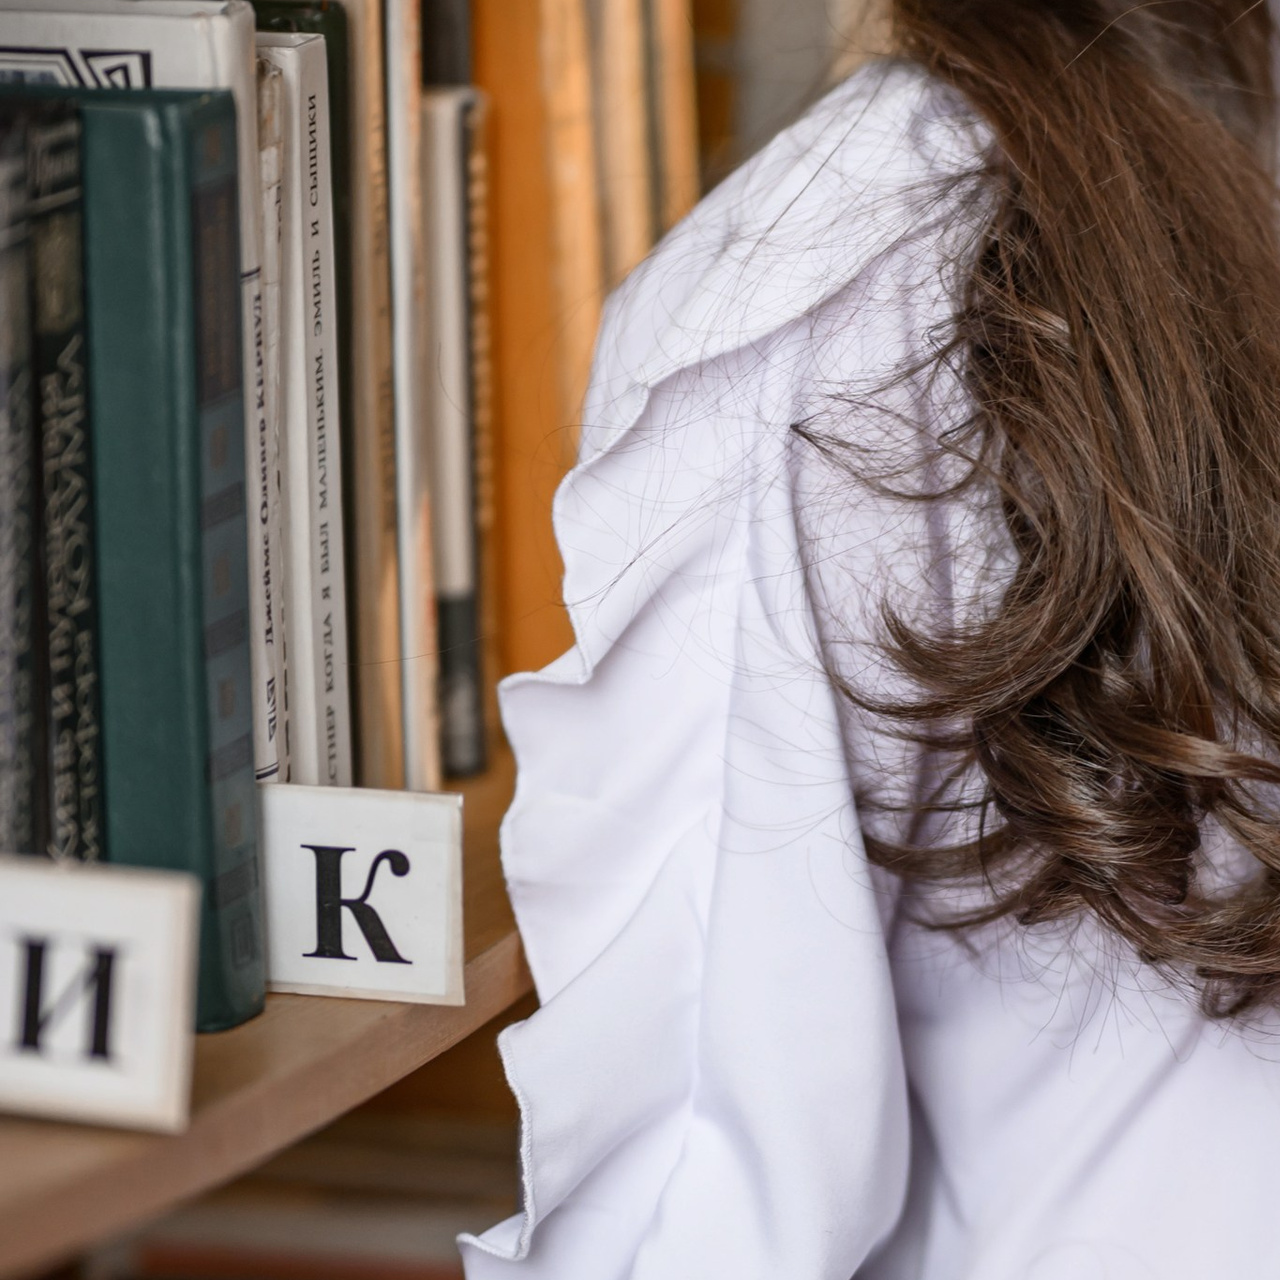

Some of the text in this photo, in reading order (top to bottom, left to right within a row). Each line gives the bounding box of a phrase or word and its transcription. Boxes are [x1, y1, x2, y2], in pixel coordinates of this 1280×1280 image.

[306, 93, 321, 207] СЫЩИКИ
[310, 219, 320, 238] И
[311, 248, 324, 337] ЭМИЛЬ
[319, 520, 332, 575] БЫЛ
[320, 582, 332, 600] Я
[322, 613, 335, 691] КОГДА
[324, 703, 338, 787] СТНЕР
[300, 844, 412, 965] К
[15, 934, 118, 1062] И
